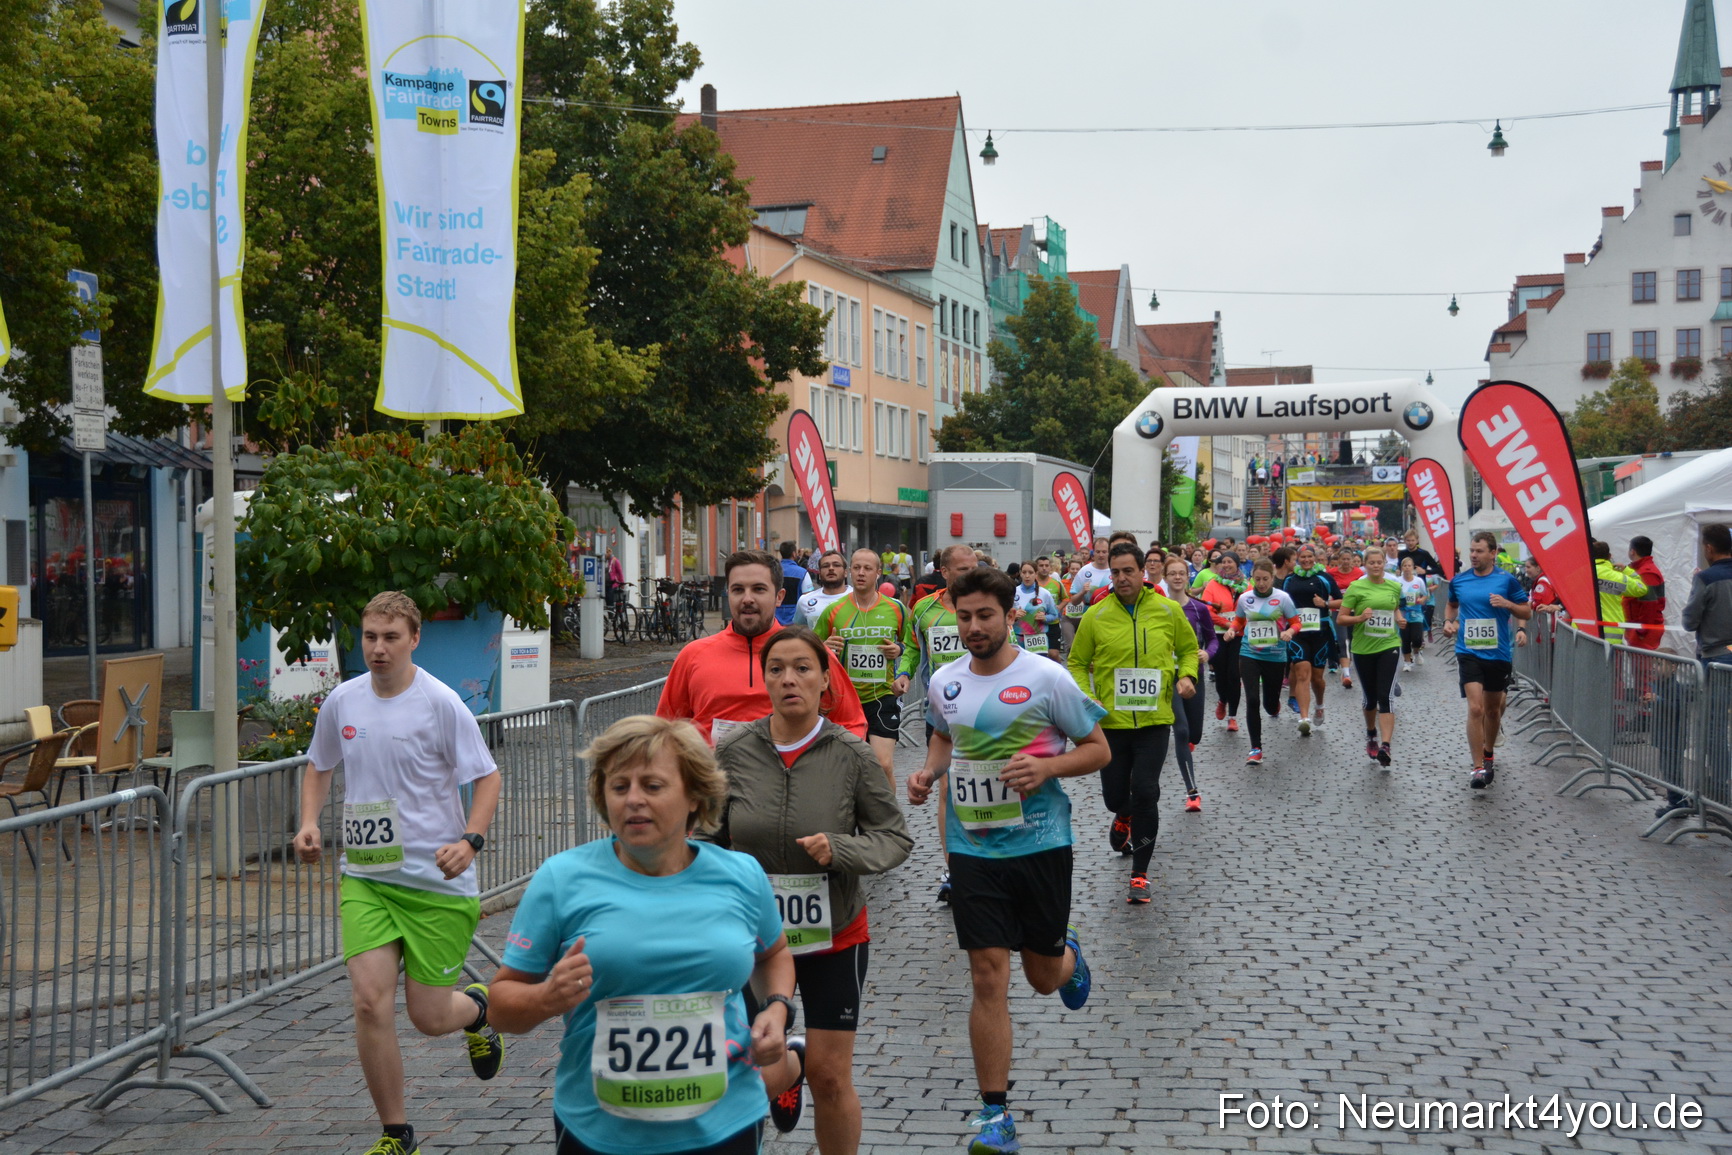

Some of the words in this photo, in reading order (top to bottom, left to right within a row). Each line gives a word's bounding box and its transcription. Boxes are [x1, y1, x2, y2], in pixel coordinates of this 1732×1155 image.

[385, 73, 454, 93] Kampagne
[385, 86, 463, 108] Fairtrade
[419, 112, 457, 128] Towns
[471, 114, 504, 125] FAIRTRADE
[394, 201, 432, 229] Wir
[438, 206, 483, 230] sind
[397, 273, 456, 301] Stadt!
[1173, 396, 1248, 420] BMW
[1256, 392, 1392, 420] Laufsport
[1333, 488, 1358, 498] ZIEL
[586, 561, 593, 572] P
[1369, 617, 1392, 627] 5144
[840, 626, 892, 640] BOCK
[1251, 627, 1274, 637] 5171
[1467, 626, 1495, 637] 5155
[1026, 636, 1046, 647] 5069
[851, 654, 884, 668] 5269
[1120, 679, 1157, 694] 5196
[1003, 690, 1028, 700] Hervis
[956, 777, 1009, 803] 5117
[356, 802, 391, 813] BOCK
[974, 810, 993, 819] Tim
[346, 817, 394, 845] 5323
[779, 877, 820, 888] BOCK
[774, 894, 822, 924] 006
[786, 934, 802, 944] net
[653, 996, 713, 1014] BOCK
[608, 1022, 716, 1072] 5224
[622, 1083, 701, 1104] Elisabeth
